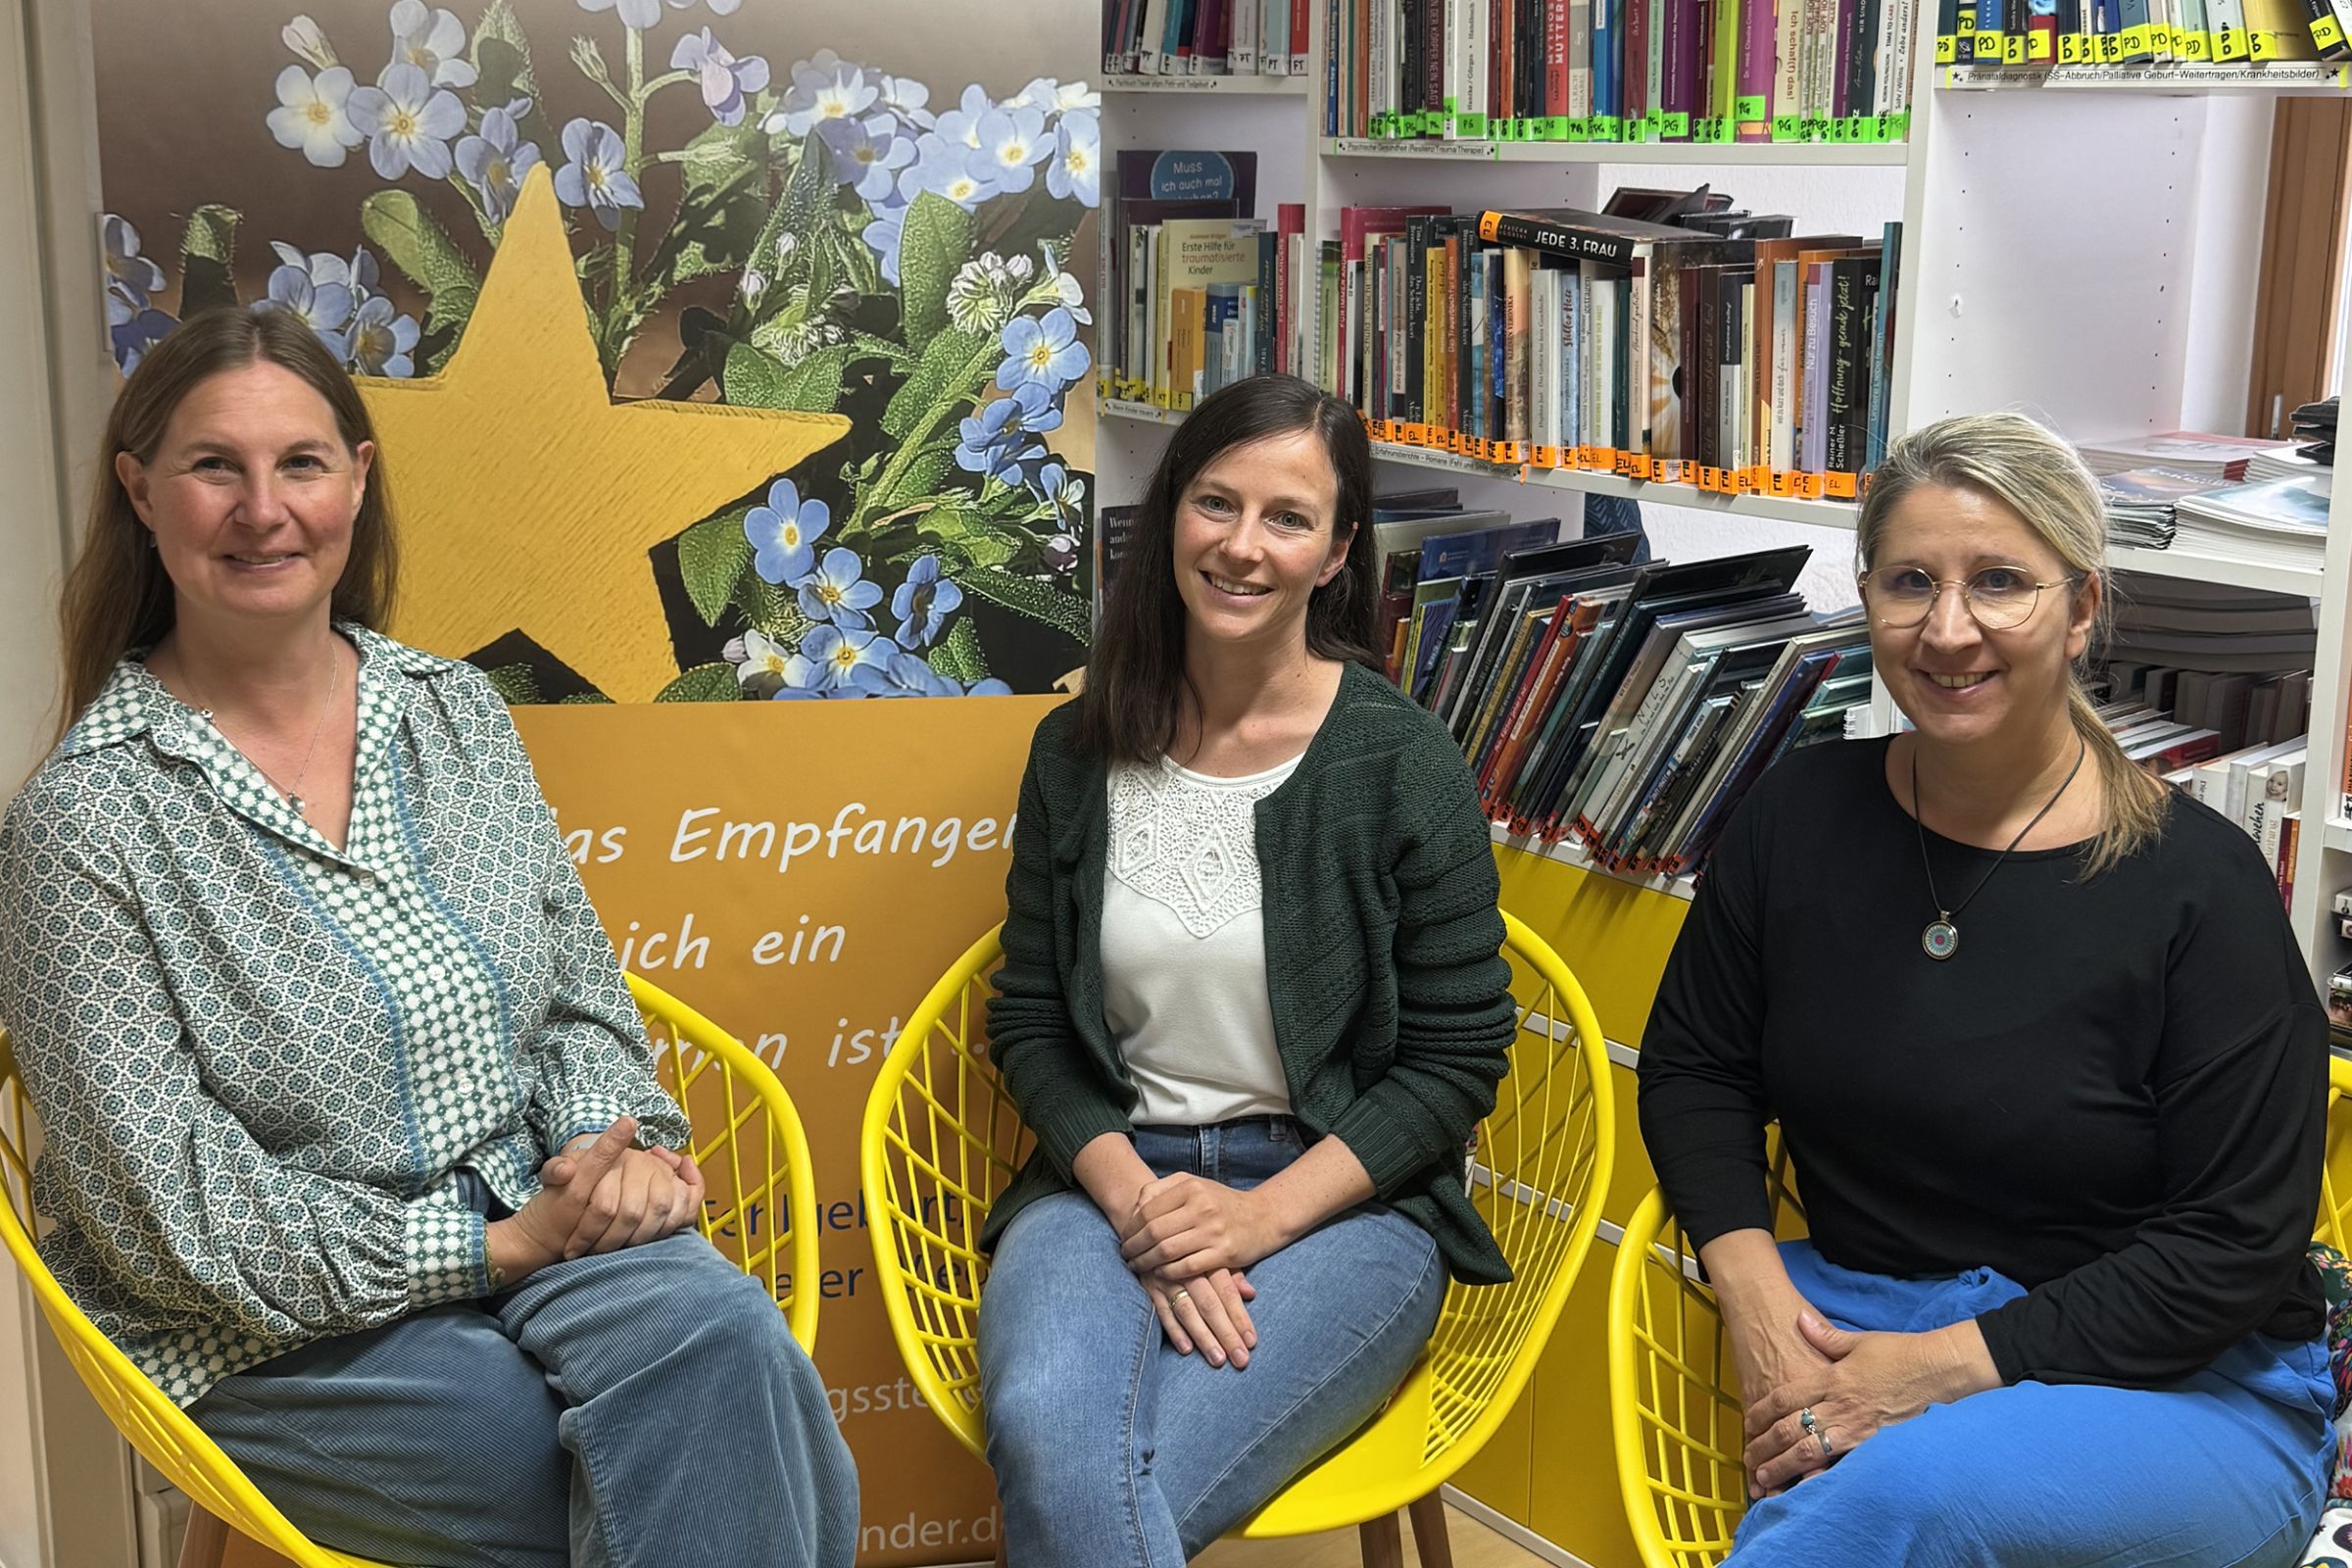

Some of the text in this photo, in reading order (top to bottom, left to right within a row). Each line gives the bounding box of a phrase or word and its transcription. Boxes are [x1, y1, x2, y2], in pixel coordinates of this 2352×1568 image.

[1555, 0, 1564, 64] MUTTER
[1789, 10, 1798, 27] Ich
[1160, 174, 1223, 192] ich auch mal
[1173, 161, 1203, 174] Muss
[1181, 253, 1246, 264] traumatisierte
[1182, 241, 1236, 253] Erste Hilfe für
[1535, 229, 1618, 259] JEDE 3. FRAU
[1188, 265, 1214, 275] Kinder
[1837, 275, 1853, 310] jetzt!
[1806, 298, 1818, 370] Nur zu Besuch
[1871, 331, 1884, 421] Unsere Liebe feiern
[1829, 423, 1837, 436] M.
[1836, 424, 1845, 469] Schießler
[550, 808, 627, 864] as
[753, 915, 846, 965] ein
[828, 1016, 903, 1068] ist
[861, 1505, 1004, 1553] nder.d
